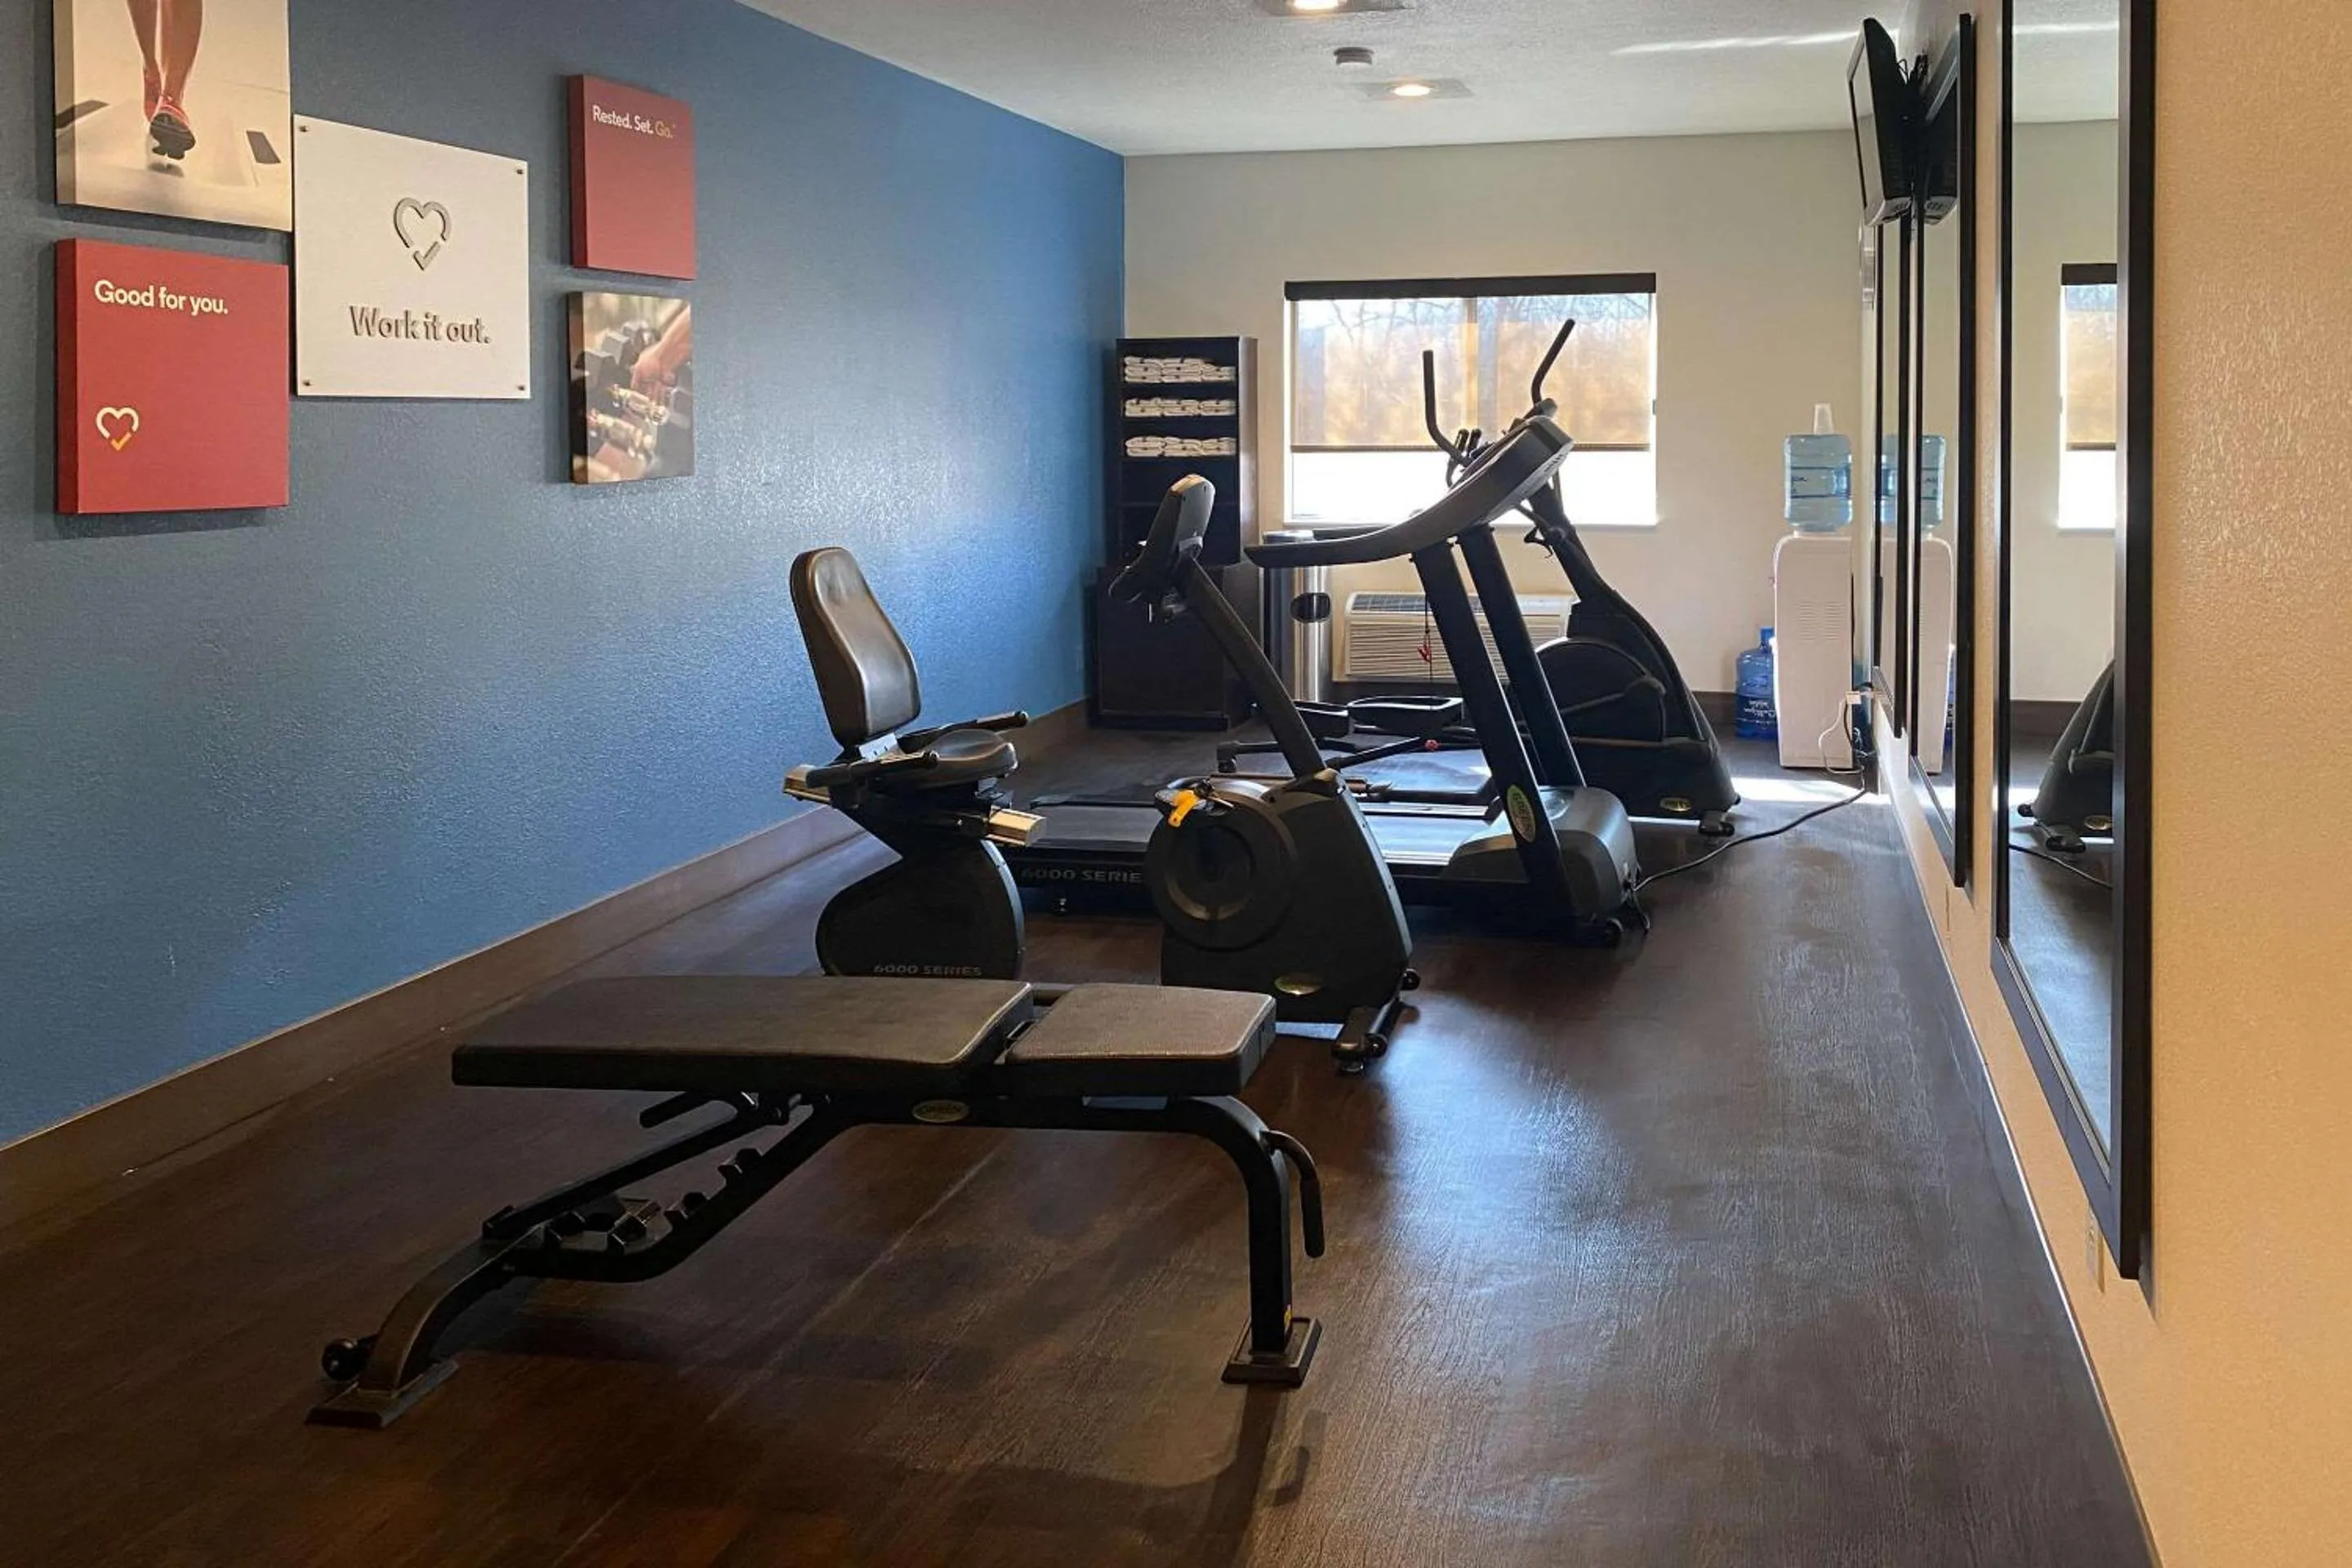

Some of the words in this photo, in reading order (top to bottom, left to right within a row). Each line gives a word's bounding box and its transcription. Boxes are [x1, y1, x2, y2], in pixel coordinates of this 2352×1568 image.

[592, 104, 632, 129] Rested.
[634, 115, 653, 134] Set.
[95, 279, 154, 307] Good
[158, 286, 186, 310] for
[189, 296, 228, 316] you.
[349, 305, 420, 340] Work
[425, 311, 442, 341] it
[446, 317, 491, 344] out.
[1021, 868, 1076, 880] 6000
[1081, 870, 1143, 884] SERIE
[873, 964, 919, 974] 6000
[923, 965, 982, 977] SERIES
